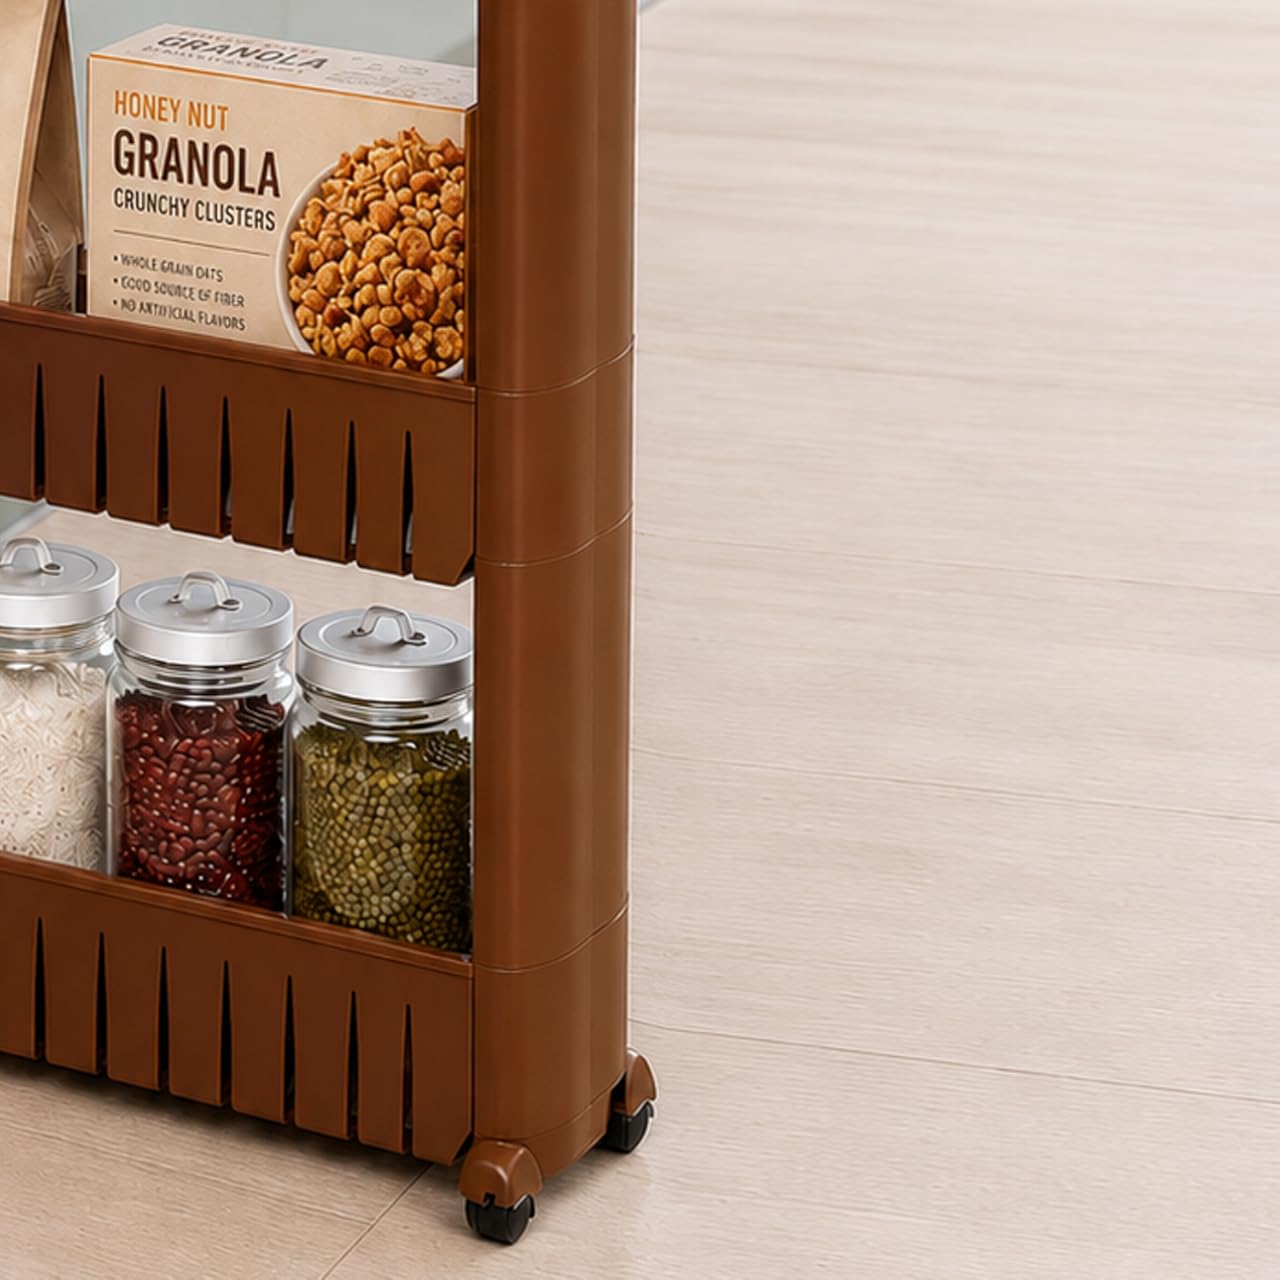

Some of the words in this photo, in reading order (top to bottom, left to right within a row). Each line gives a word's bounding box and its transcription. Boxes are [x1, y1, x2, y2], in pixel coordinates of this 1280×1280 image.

[157, 35, 329, 69] GRANOLA
[114, 89, 181, 123] HONEY
[188, 101, 229, 131] NUT
[113, 129, 281, 198] GRANOLA
[114, 187, 190, 218] CRUNCHY
[195, 200, 276, 231] CLUSTERS
[121, 253, 157, 271] WHOLE
